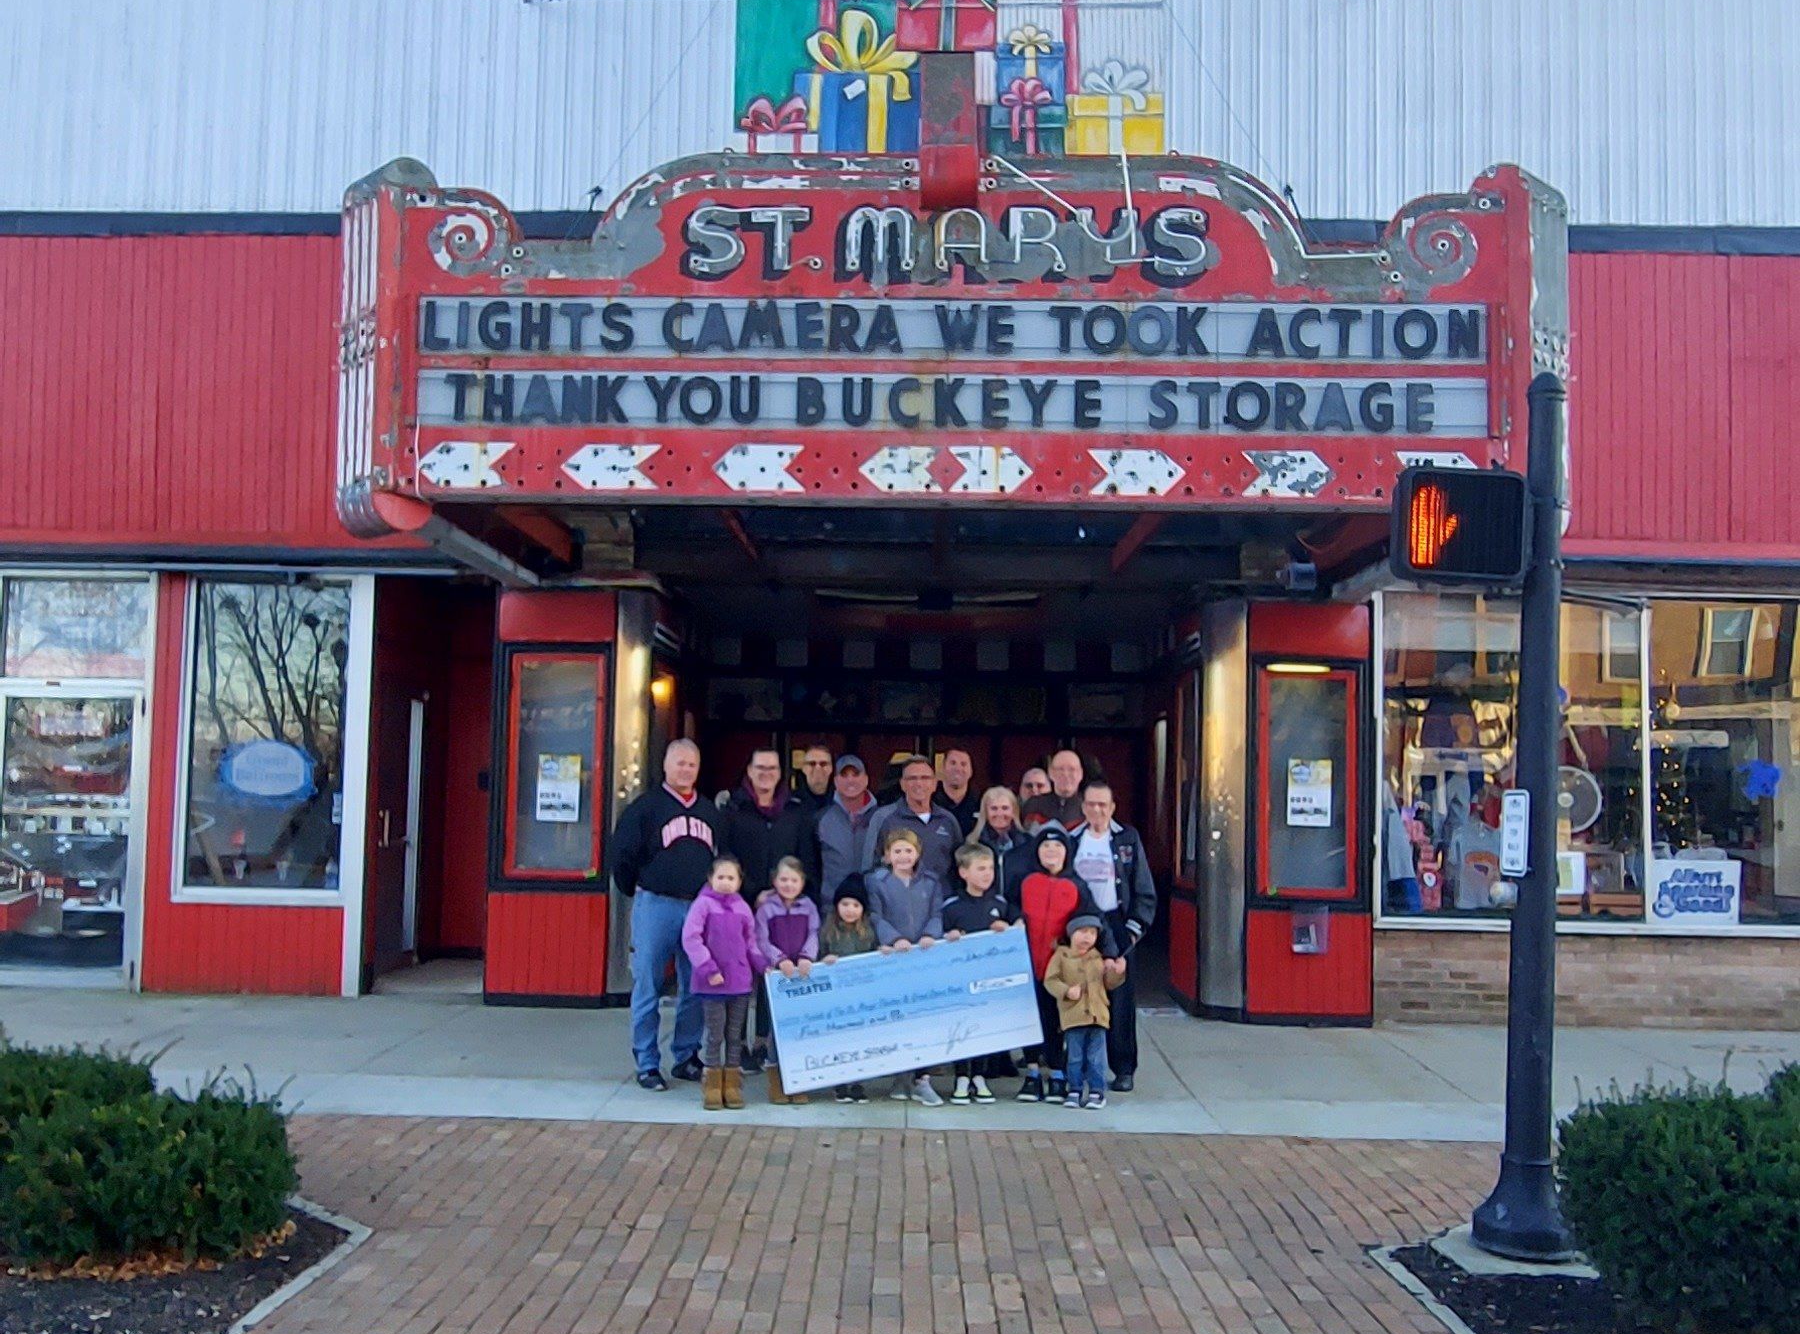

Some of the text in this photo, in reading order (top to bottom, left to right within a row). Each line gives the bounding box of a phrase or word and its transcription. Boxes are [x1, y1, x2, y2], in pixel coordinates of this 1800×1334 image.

[835, 206, 1221, 288] MARYS
[422, 299, 1481, 360] LIGHTS CAMERA WE TOOK ACTION
[796, 376, 1103, 428] BUCKEYE
[1147, 379, 1436, 434] STORAGE
[785, 980, 833, 999] THEATER
